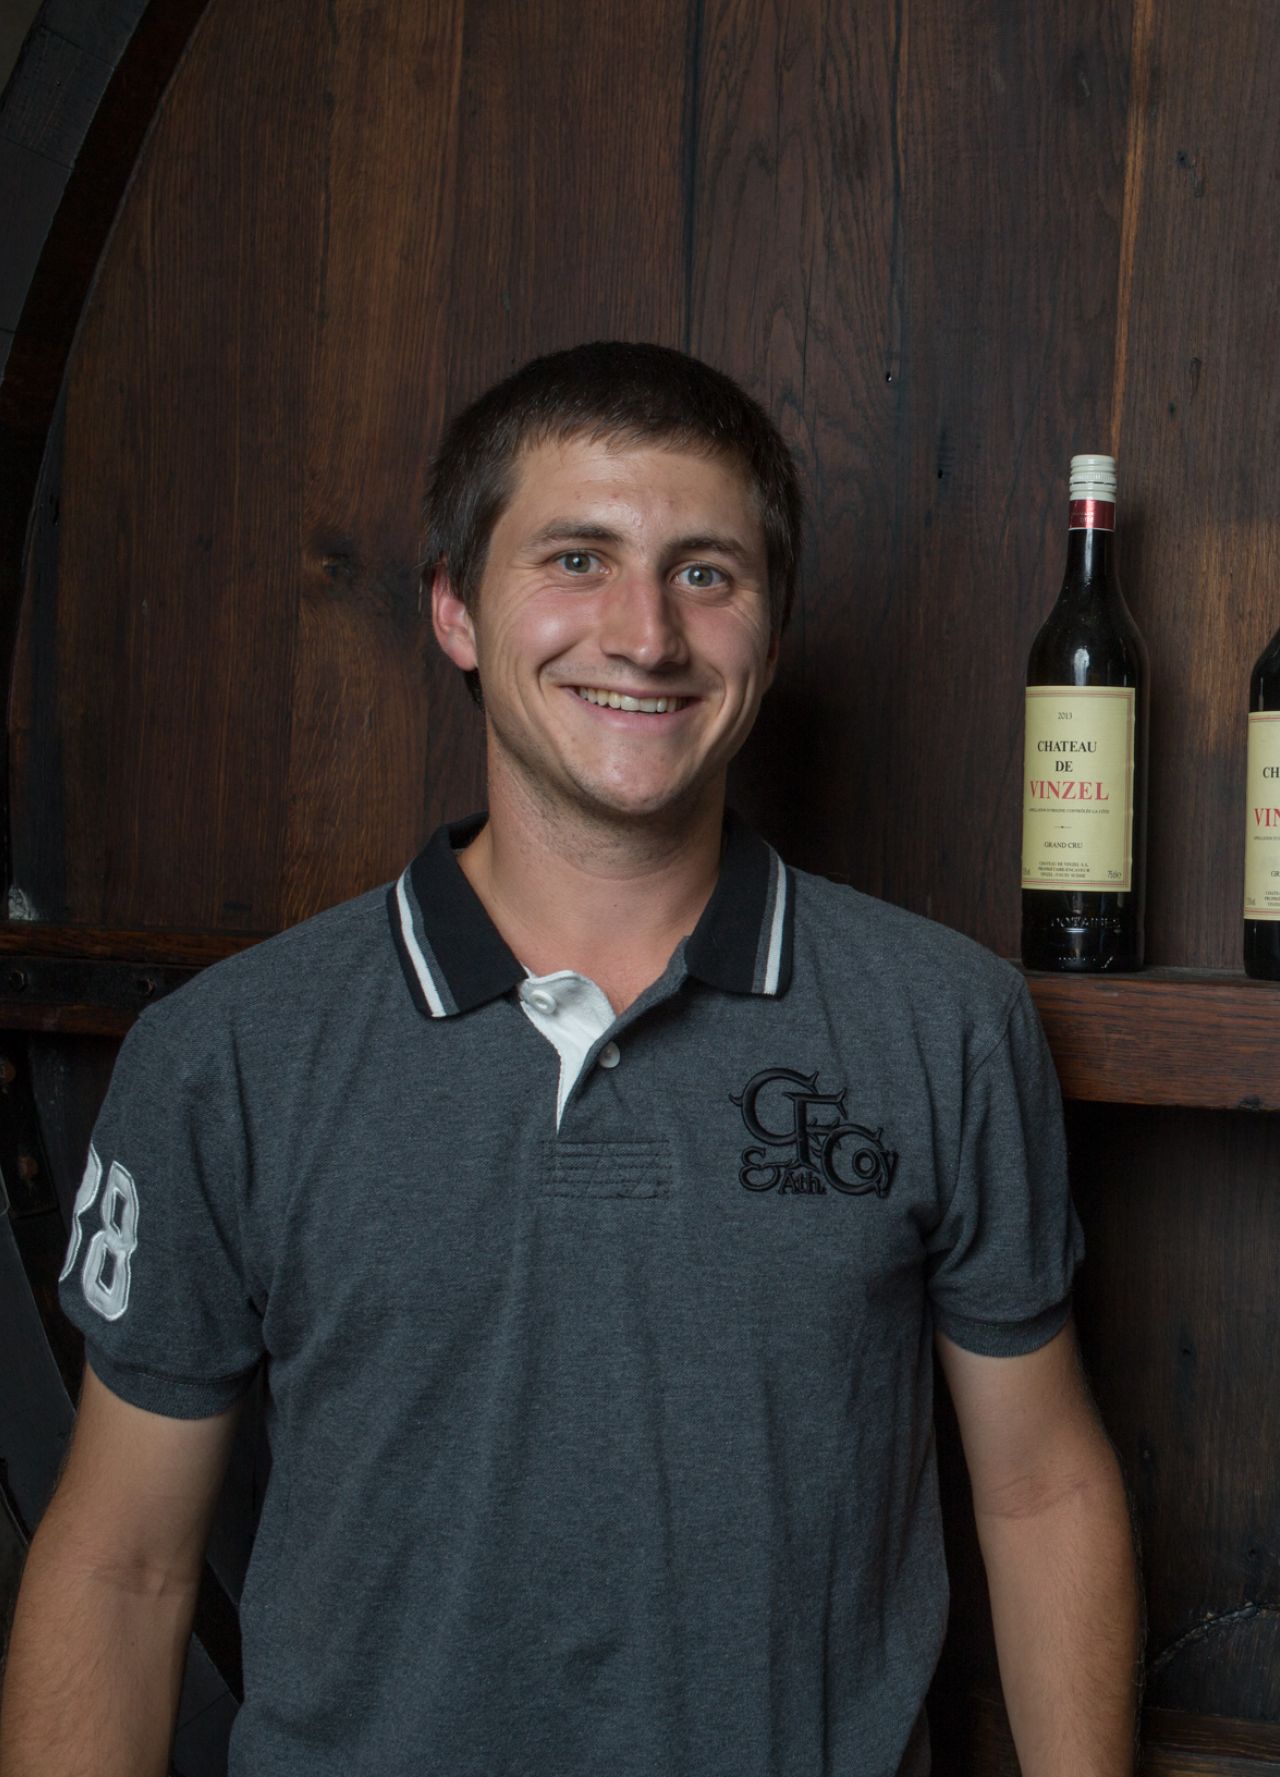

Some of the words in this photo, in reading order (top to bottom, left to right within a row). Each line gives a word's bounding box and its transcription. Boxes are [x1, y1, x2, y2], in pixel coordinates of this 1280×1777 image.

[1057, 711, 1073, 720] 2013
[1037, 740, 1097, 753] CHATEAU
[1055, 760, 1073, 772] DE
[1029, 780, 1109, 801] VINZEL
[1044, 841, 1066, 849] GRAND
[1067, 841, 1083, 849] CRU
